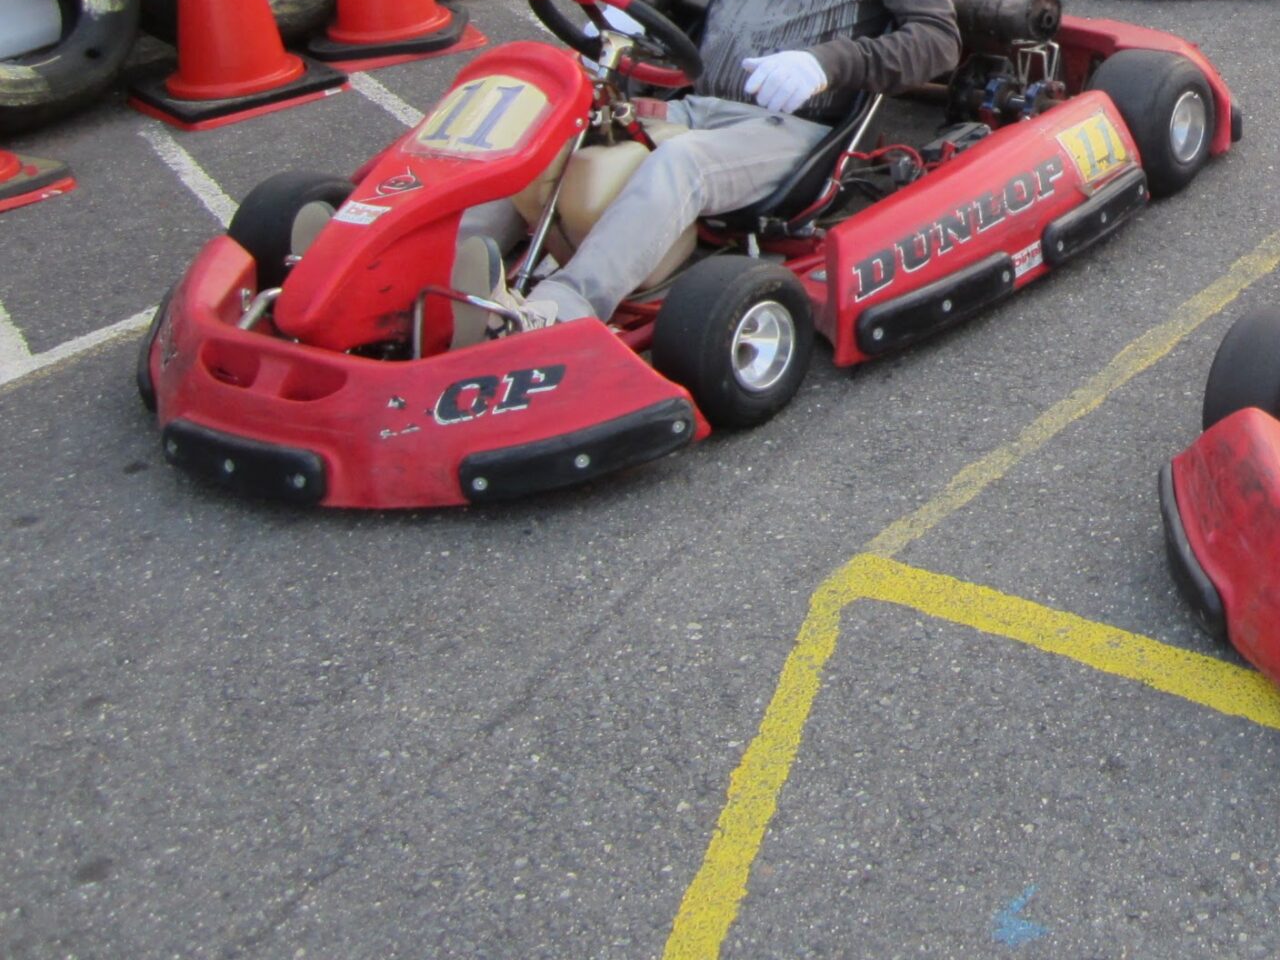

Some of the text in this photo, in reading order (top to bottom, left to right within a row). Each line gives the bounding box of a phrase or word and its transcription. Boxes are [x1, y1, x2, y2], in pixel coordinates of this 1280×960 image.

[420, 80, 526, 150] 11
[1075, 120, 1118, 176] 11
[852, 155, 1064, 303] DUNLOP
